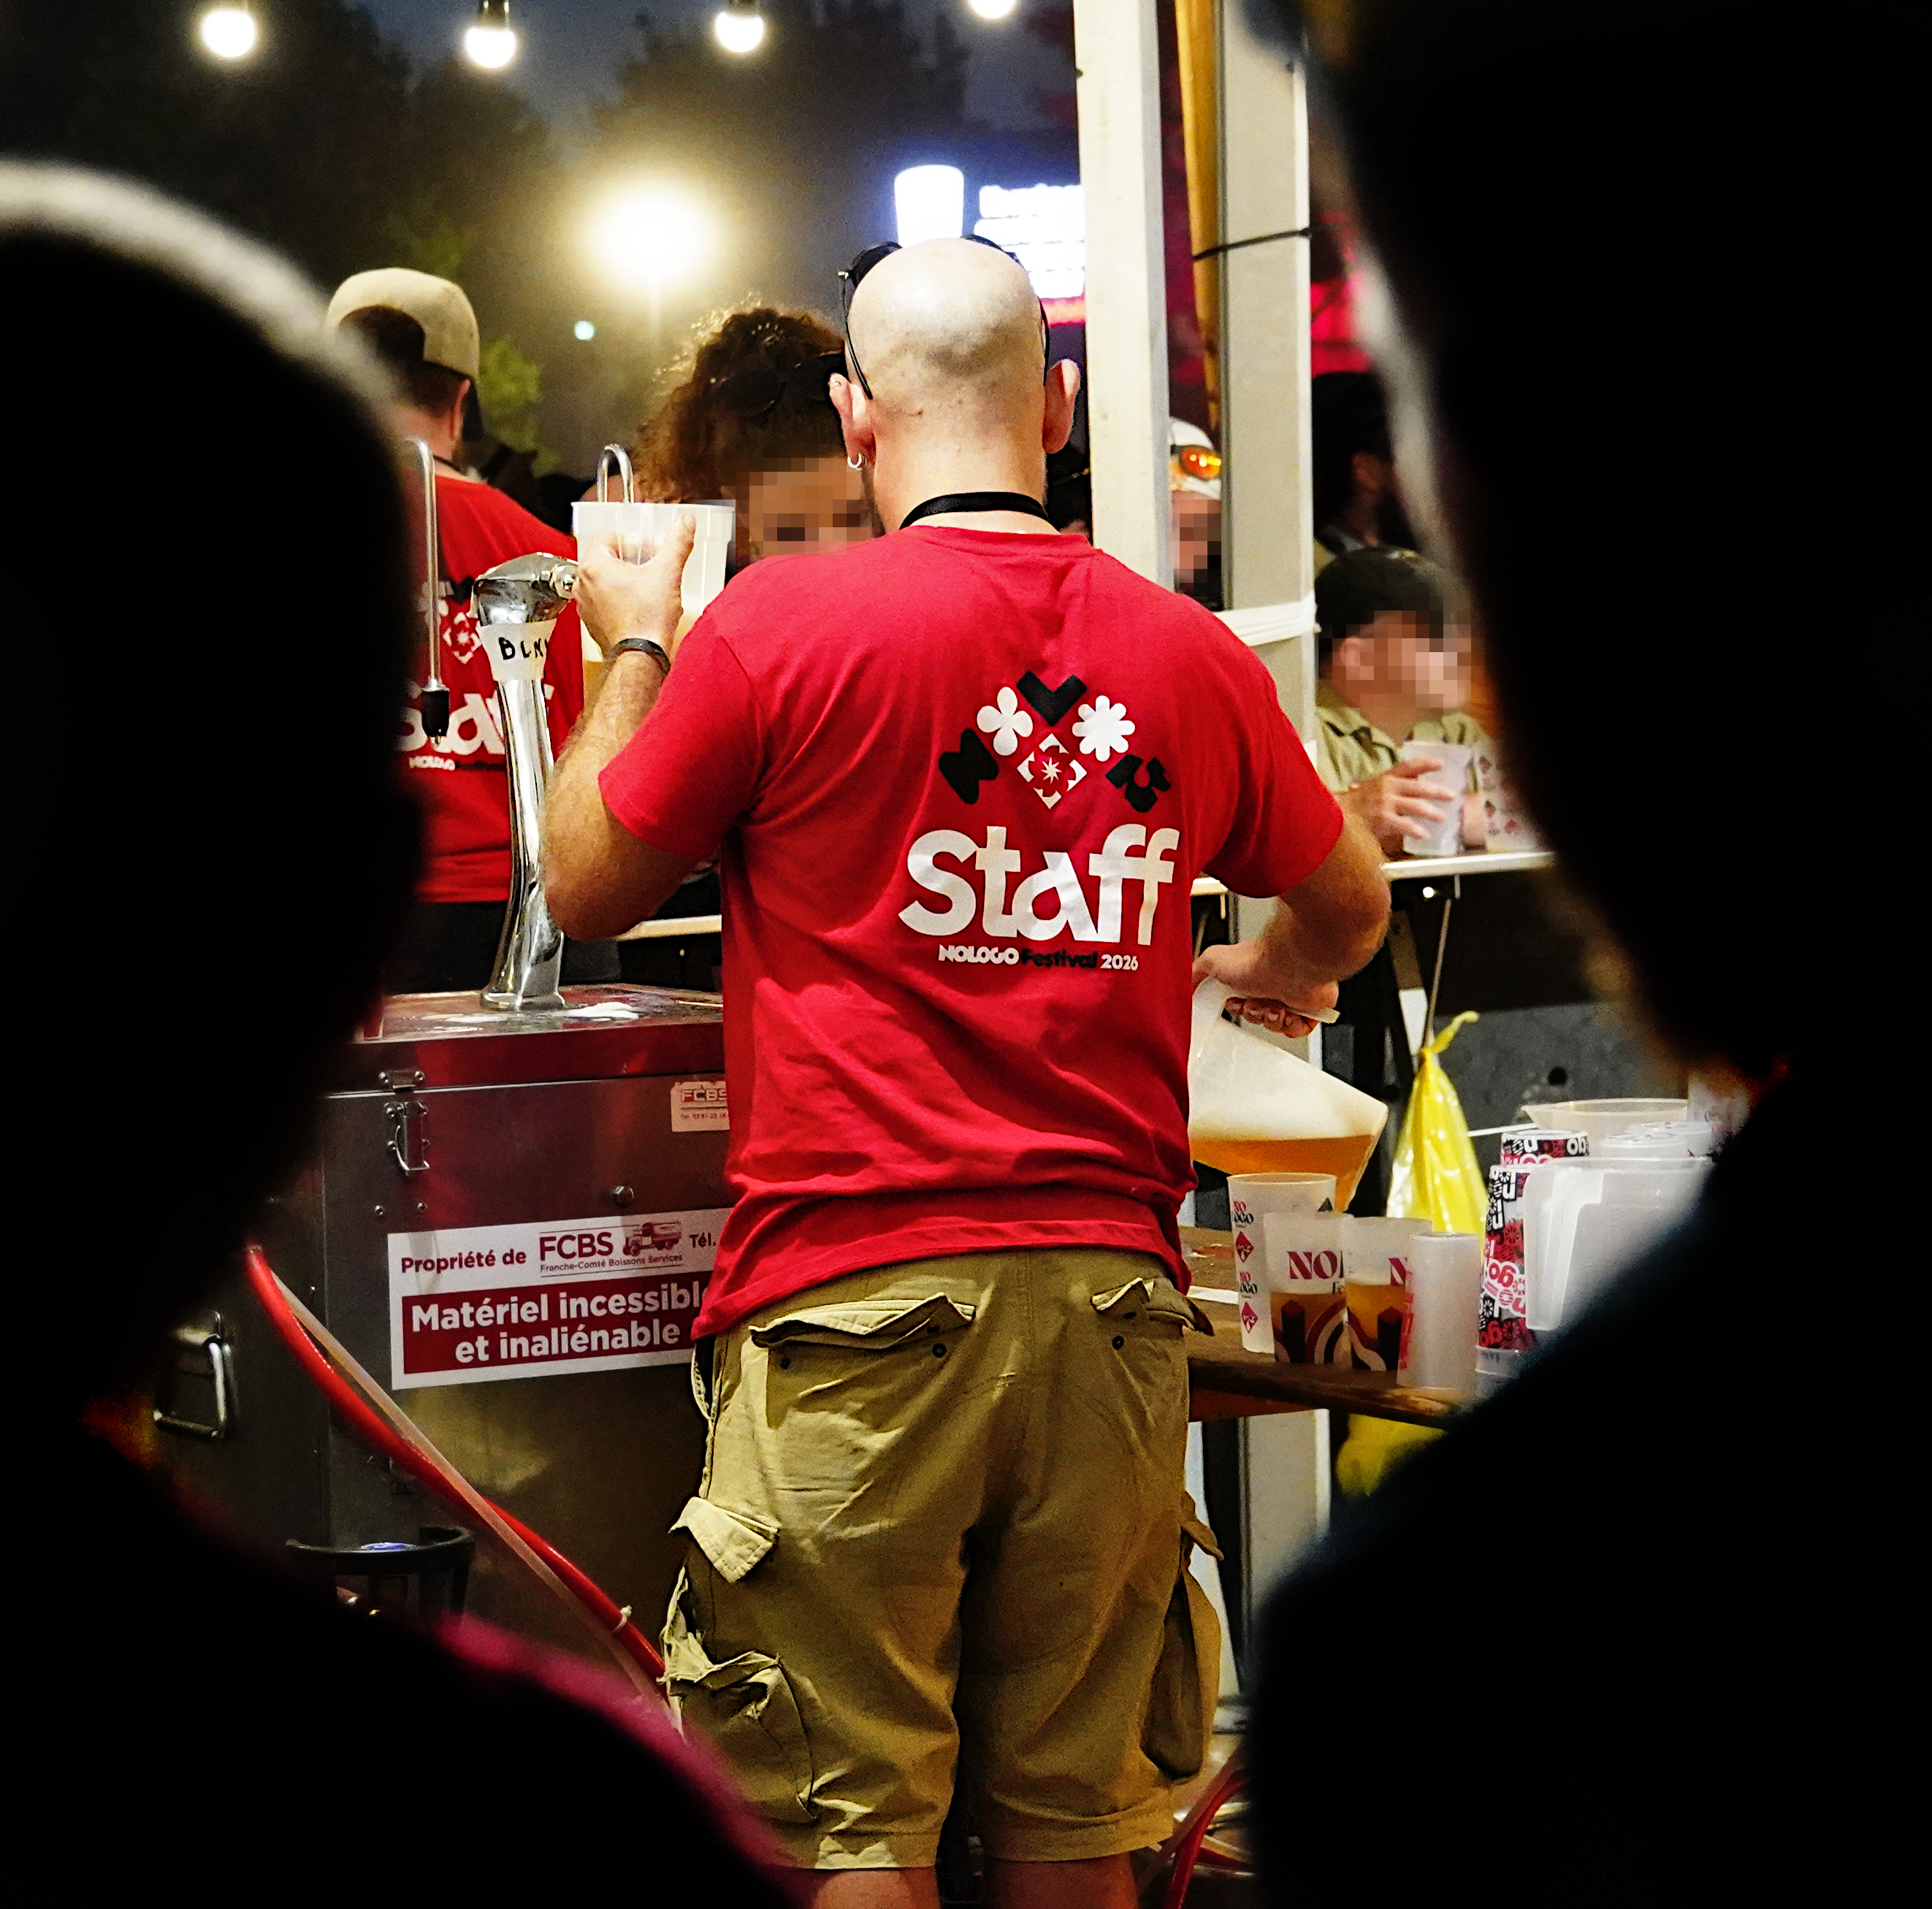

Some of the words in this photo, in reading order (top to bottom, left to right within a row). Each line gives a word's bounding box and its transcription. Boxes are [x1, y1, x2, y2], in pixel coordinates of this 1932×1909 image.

[898, 823, 1180, 945] Staff
[938, 944, 1020, 965] NOLOGO
[1022, 949, 1098, 968] Festival
[1100, 954, 1139, 971] 2026
[681, 1088, 728, 1101] FCBS
[539, 1231, 614, 1261] FCBS
[690, 1231, 716, 1248] Tél.
[402, 1250, 496, 1274] Propriété
[502, 1248, 527, 1266] de
[540, 1260, 606, 1273] Franche-Comté
[609, 1258, 646, 1268] Boissons
[649, 1254, 683, 1264] Services
[412, 1293, 549, 1332] Matériel
[455, 1335, 489, 1363] et
[500, 1318, 681, 1361] inaliénable
